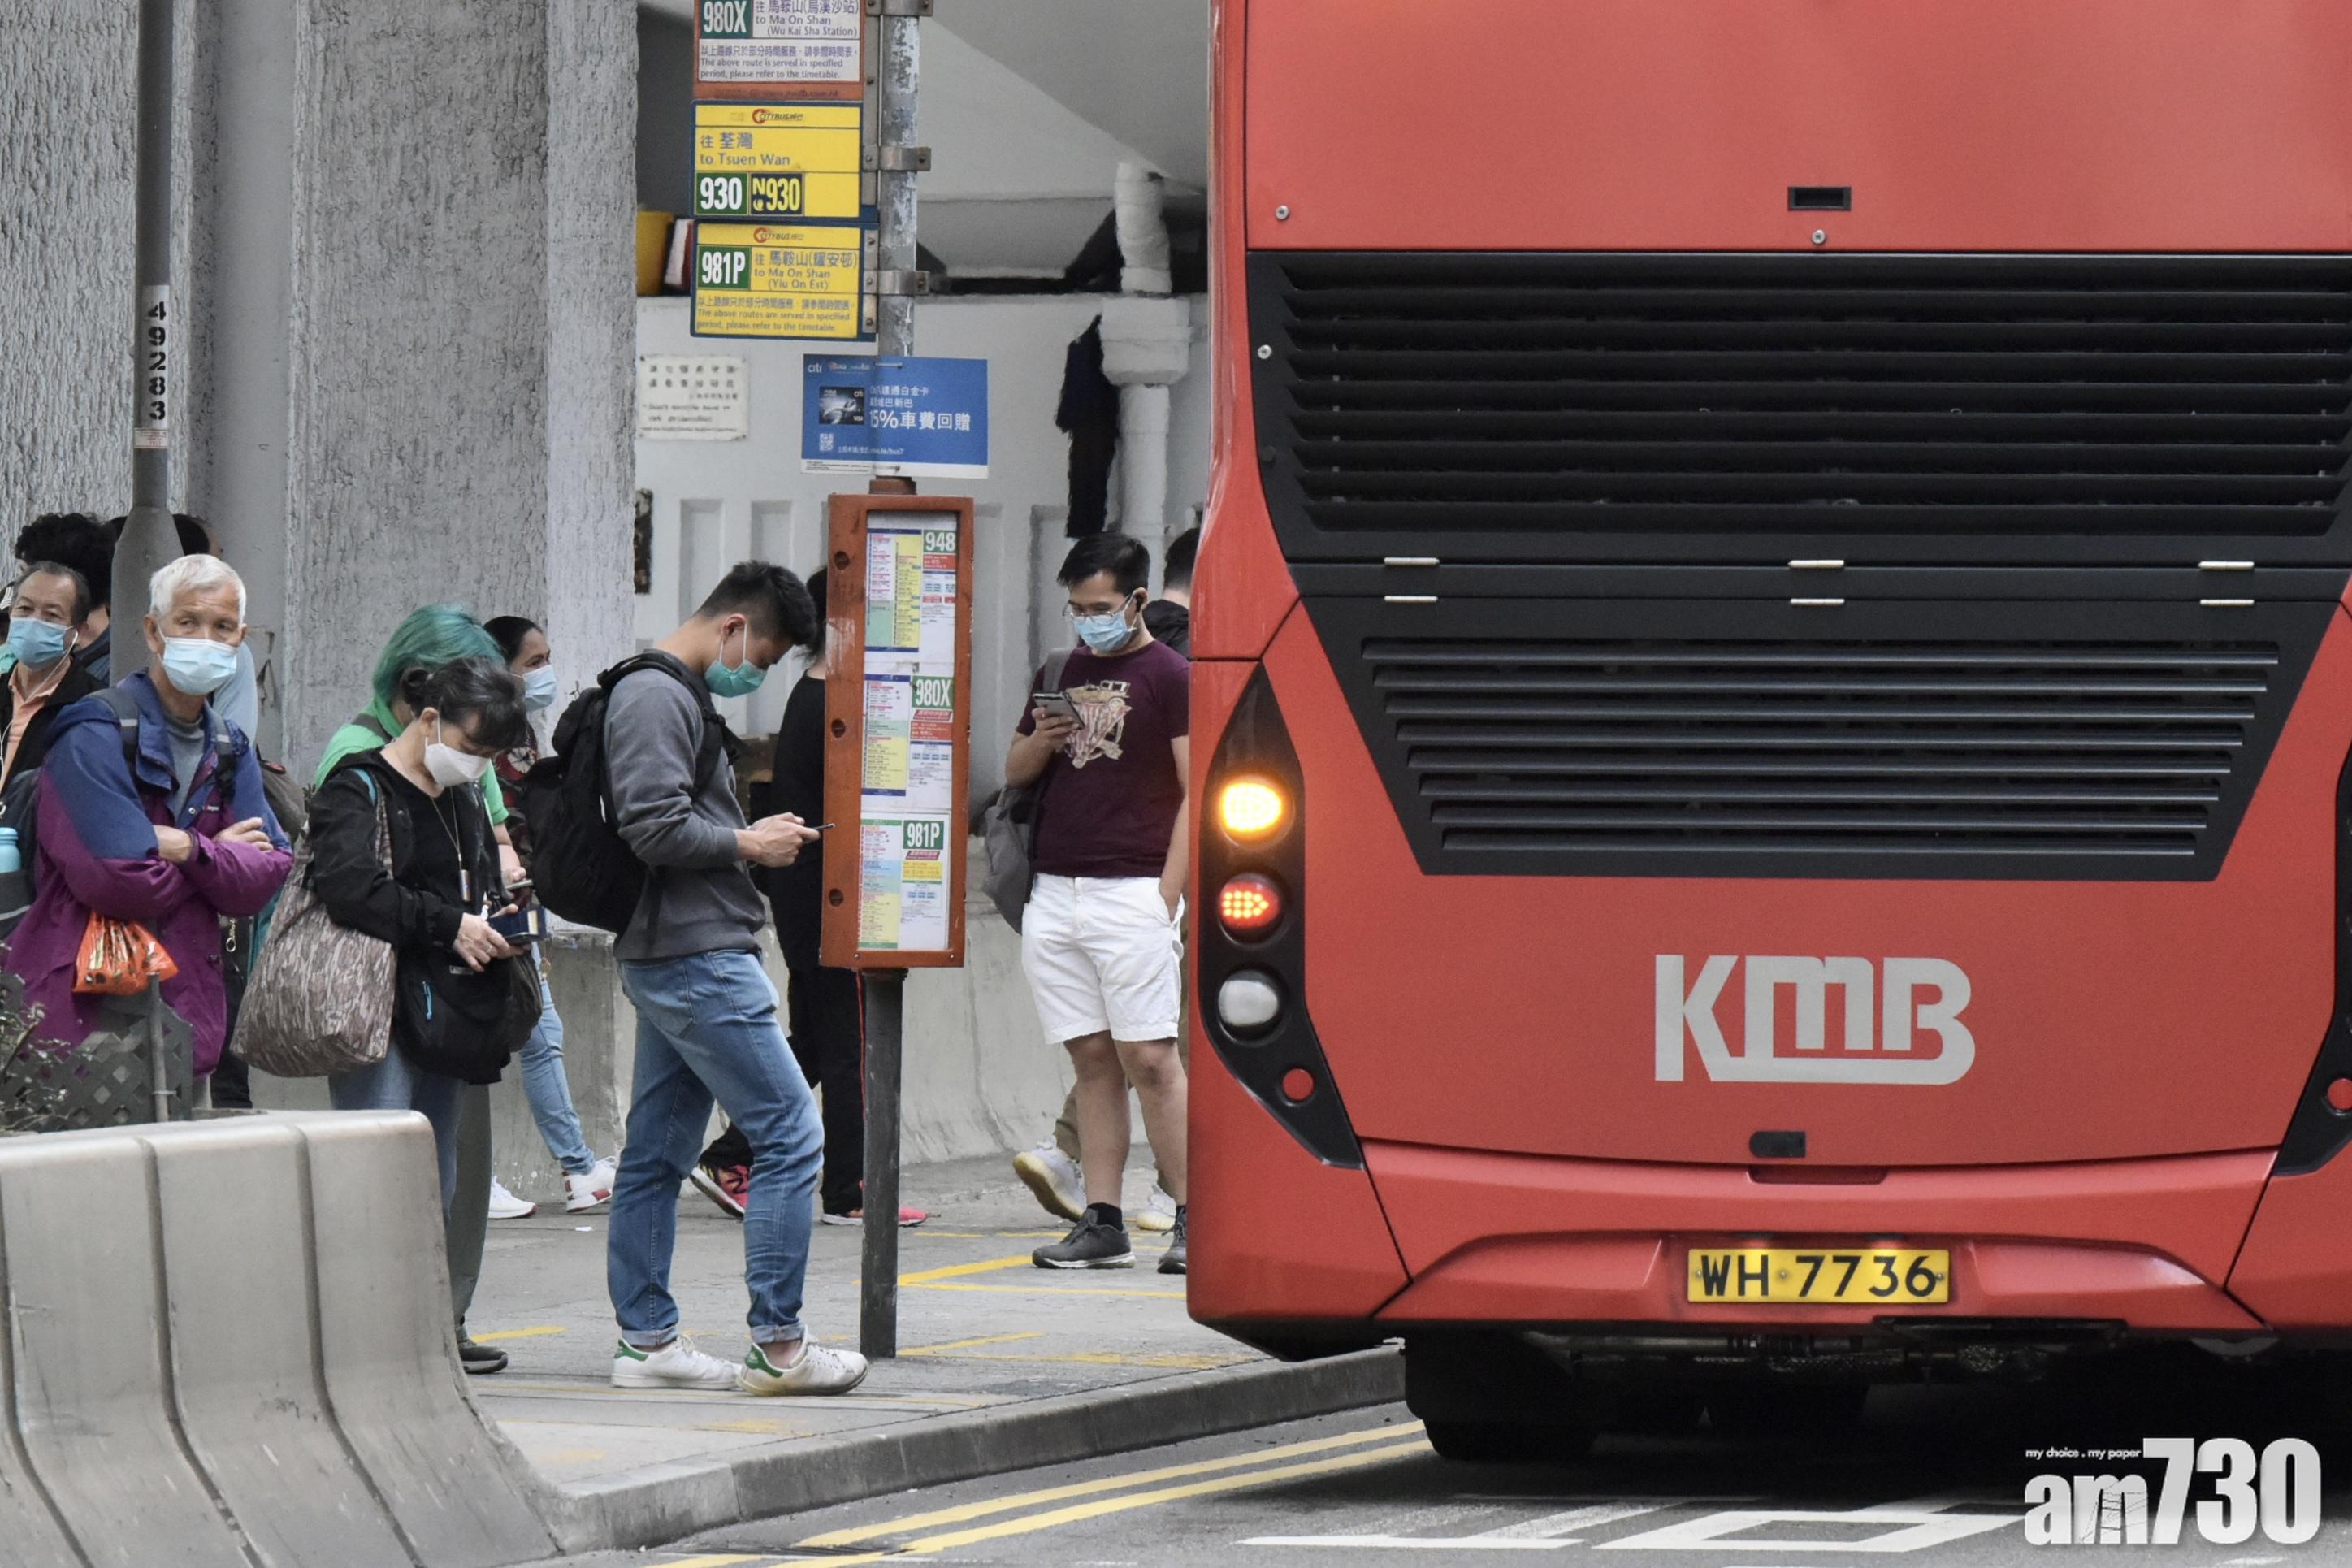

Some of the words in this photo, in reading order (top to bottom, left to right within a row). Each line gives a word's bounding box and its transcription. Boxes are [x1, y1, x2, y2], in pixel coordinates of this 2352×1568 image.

[704, 1, 747, 33] 980X
[756, 16, 766, 24] to
[769, 15, 786, 24] Ma
[788, 15, 803, 24] On
[806, 16, 831, 25] Shan
[767, 26, 786, 37] (Wu
[788, 26, 801, 35] Kai
[804, 27, 820, 36] Sha
[823, 27, 858, 37] Station)
[701, 58, 715, 67] The
[717, 58, 739, 67] above
[773, 59, 797, 67] served
[800, 59, 808, 67] in
[809, 58, 843, 68] specified
[700, 70, 728, 80] period,
[730, 71, 753, 80] please
[756, 71, 774, 79] refer
[777, 71, 785, 79] to
[787, 71, 799, 79] the
[700, 135, 713, 149] 往
[720, 132, 753, 149] 荃灣
[700, 154, 713, 165] to
[719, 153, 756, 166] Tsuen
[760, 154, 790, 166] Wan
[700, 177, 743, 210] 930
[752, 178, 801, 211] N930
[755, 253, 765, 266] 往
[702, 251, 746, 284] 981P
[754, 269, 765, 277] to
[769, 269, 785, 278] Ma
[787, 269, 803, 278] On
[806, 269, 831, 279] Shan
[768, 279, 788, 289] (Yiu
[791, 279, 807, 288] On
[809, 279, 829, 291] Est)
[698, 309, 712, 318] The
[716, 310, 736, 318] above
[739, 310, 763, 319] routes
[765, 311, 777, 319] are
[779, 311, 803, 320] served
[806, 312, 814, 320] in
[816, 311, 851, 322] specified
[726, 321, 750, 331] please
[752, 322, 771, 331] refer
[773, 323, 782, 331] to
[783, 322, 796, 331] the
[147, 301, 167, 421] 49283
[808, 362, 822, 374] citi
[869, 409, 971, 431] 15%車費回贈
[925, 531, 956, 552] 948
[907, 822, 940, 848] 981P
[1701, 1255, 1769, 1297] WH
[1795, 1255, 1937, 1297] 7736
